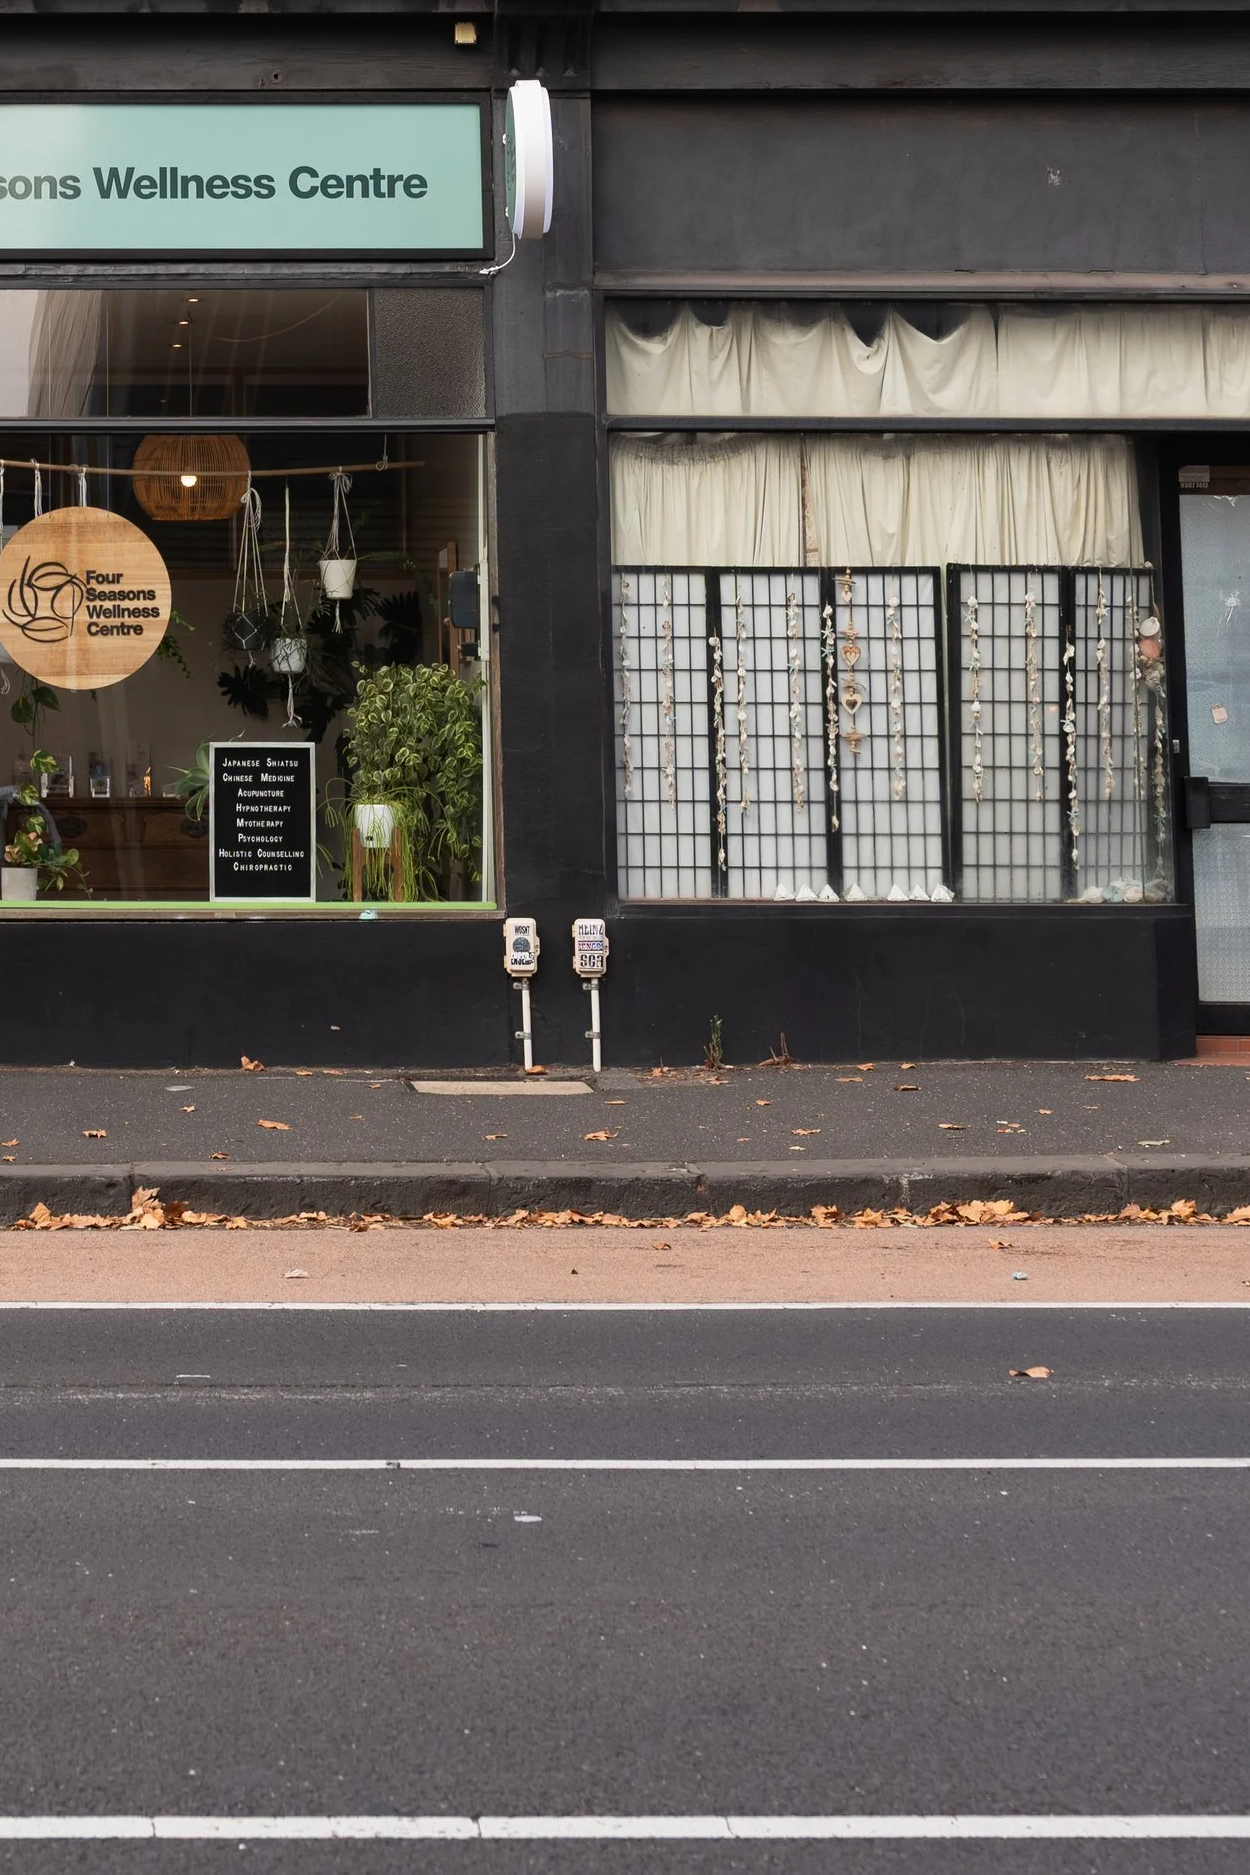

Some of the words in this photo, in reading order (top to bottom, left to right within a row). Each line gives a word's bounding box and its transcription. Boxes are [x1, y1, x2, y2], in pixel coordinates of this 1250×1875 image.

[92, 166, 276, 200] Wellness
[288, 165, 428, 200] Centre
[85, 570, 124, 585] Four
[85, 586, 157, 602] Seasons
[86, 605, 160, 619] Wellness
[87, 621, 144, 637] Centre
